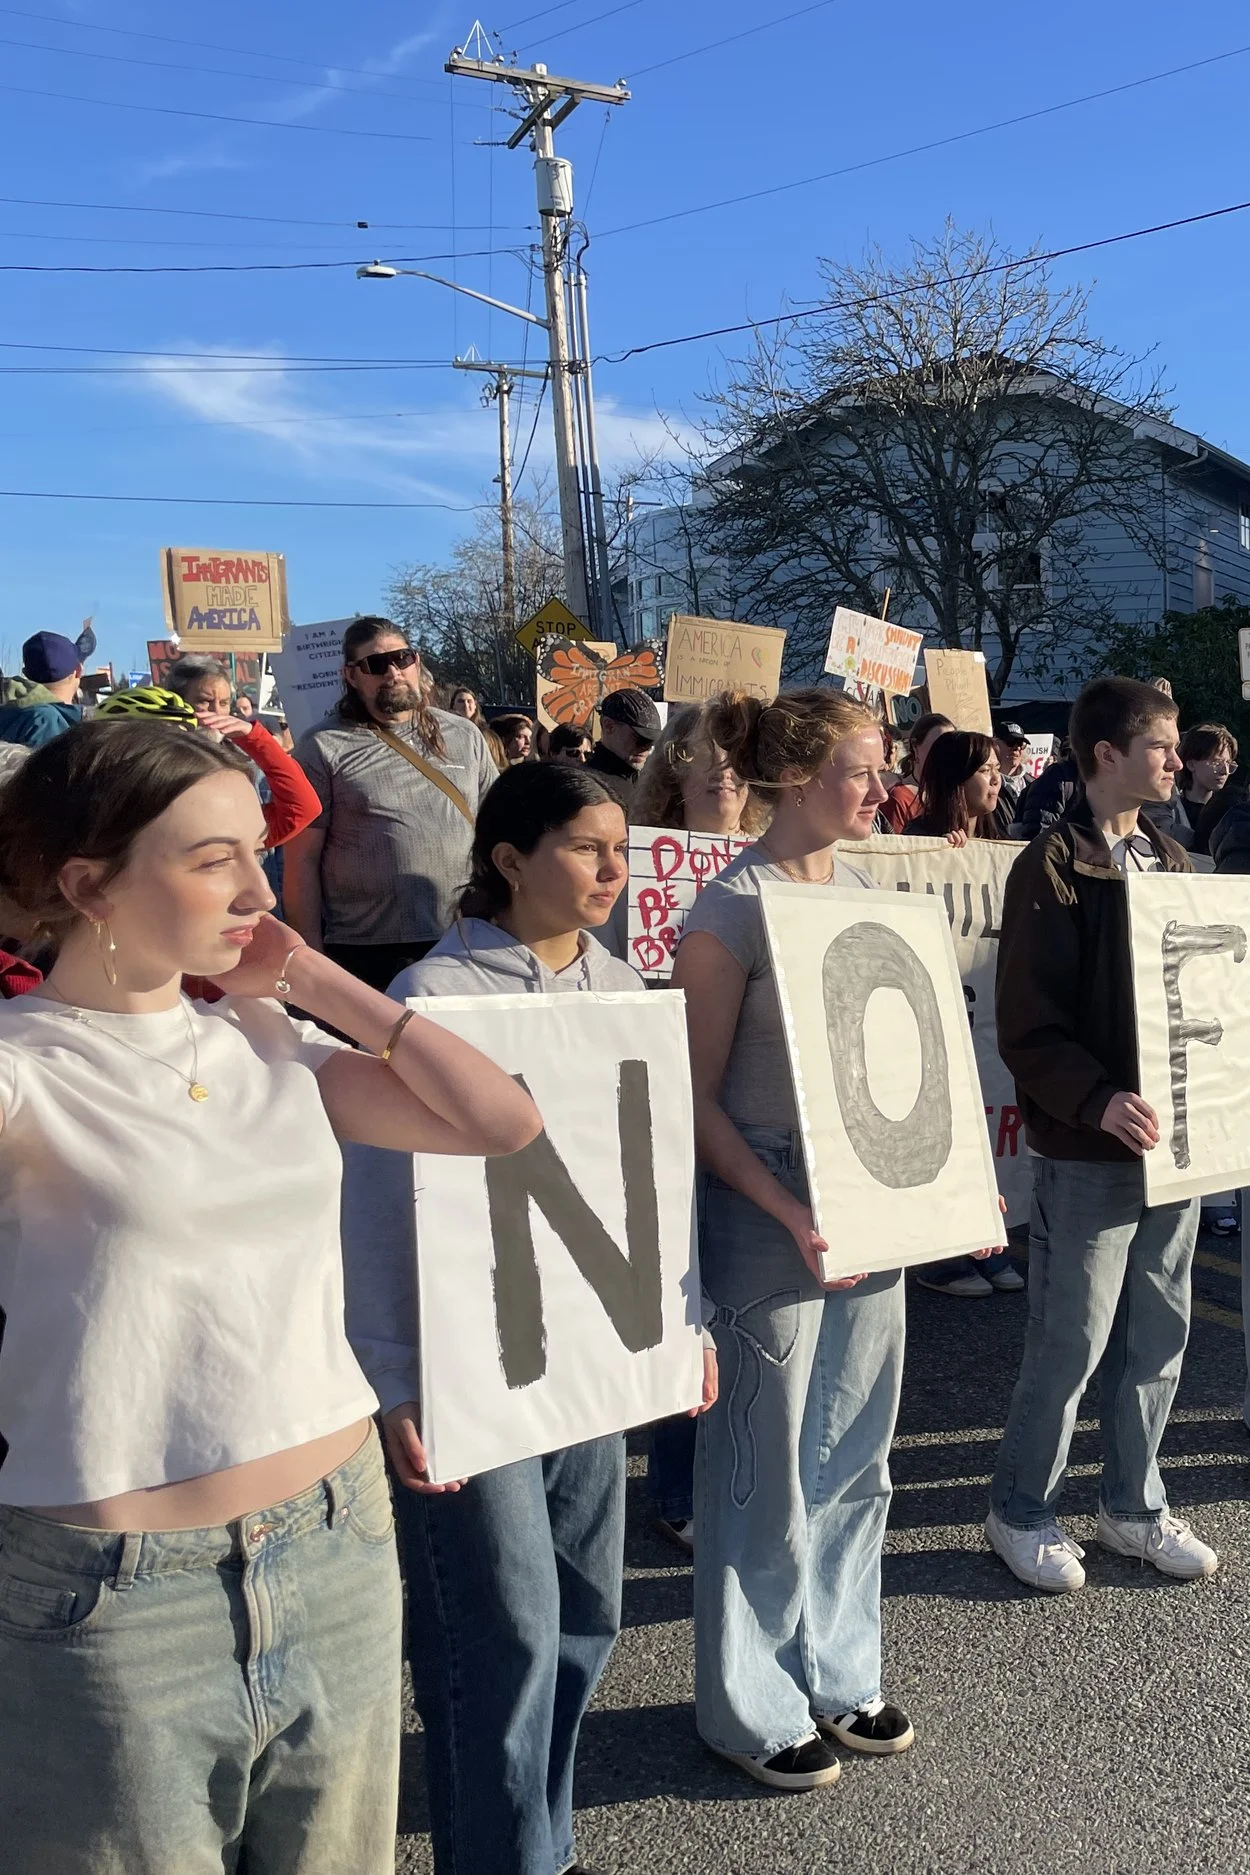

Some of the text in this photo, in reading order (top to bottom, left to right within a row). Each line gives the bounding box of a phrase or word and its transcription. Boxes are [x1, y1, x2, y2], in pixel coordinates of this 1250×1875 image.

[206, 585, 258, 607] MADE
[187, 606, 261, 631] AMERICA
[536, 621, 576, 636] STOP
[312, 631, 326, 639] AM
[679, 628, 742, 660] AMERICA
[699, 657, 718, 667] NATION
[1026, 747, 1049, 755] OLISH
[637, 884, 680, 930] BE
[822, 920, 952, 1190] O
[1162, 919, 1248, 1170] F
[485, 1059, 663, 1390] N
